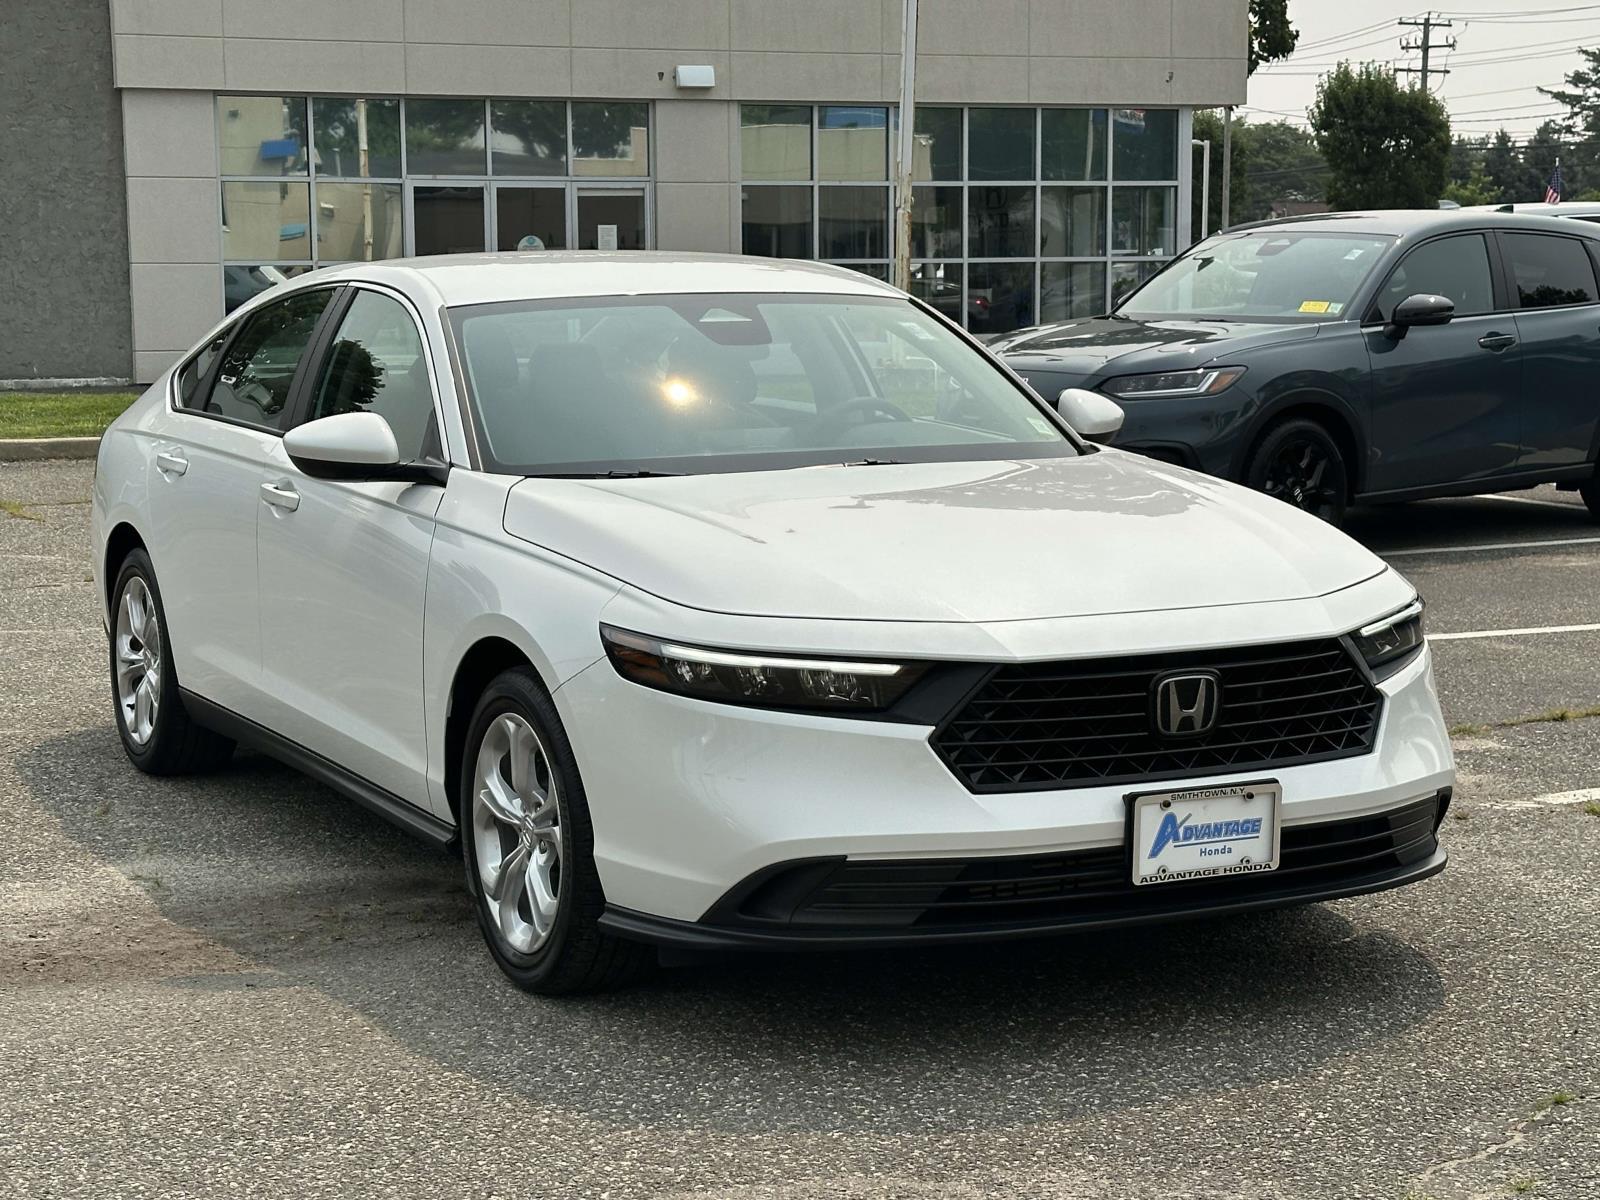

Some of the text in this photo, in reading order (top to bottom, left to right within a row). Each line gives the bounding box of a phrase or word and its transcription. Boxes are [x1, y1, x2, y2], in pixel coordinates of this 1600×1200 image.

[1147, 811, 1263, 859] ADVANTAGE
[1199, 845, 1232, 857] Honda
[1139, 863, 1272, 884] ADVANTAGE HONDA
